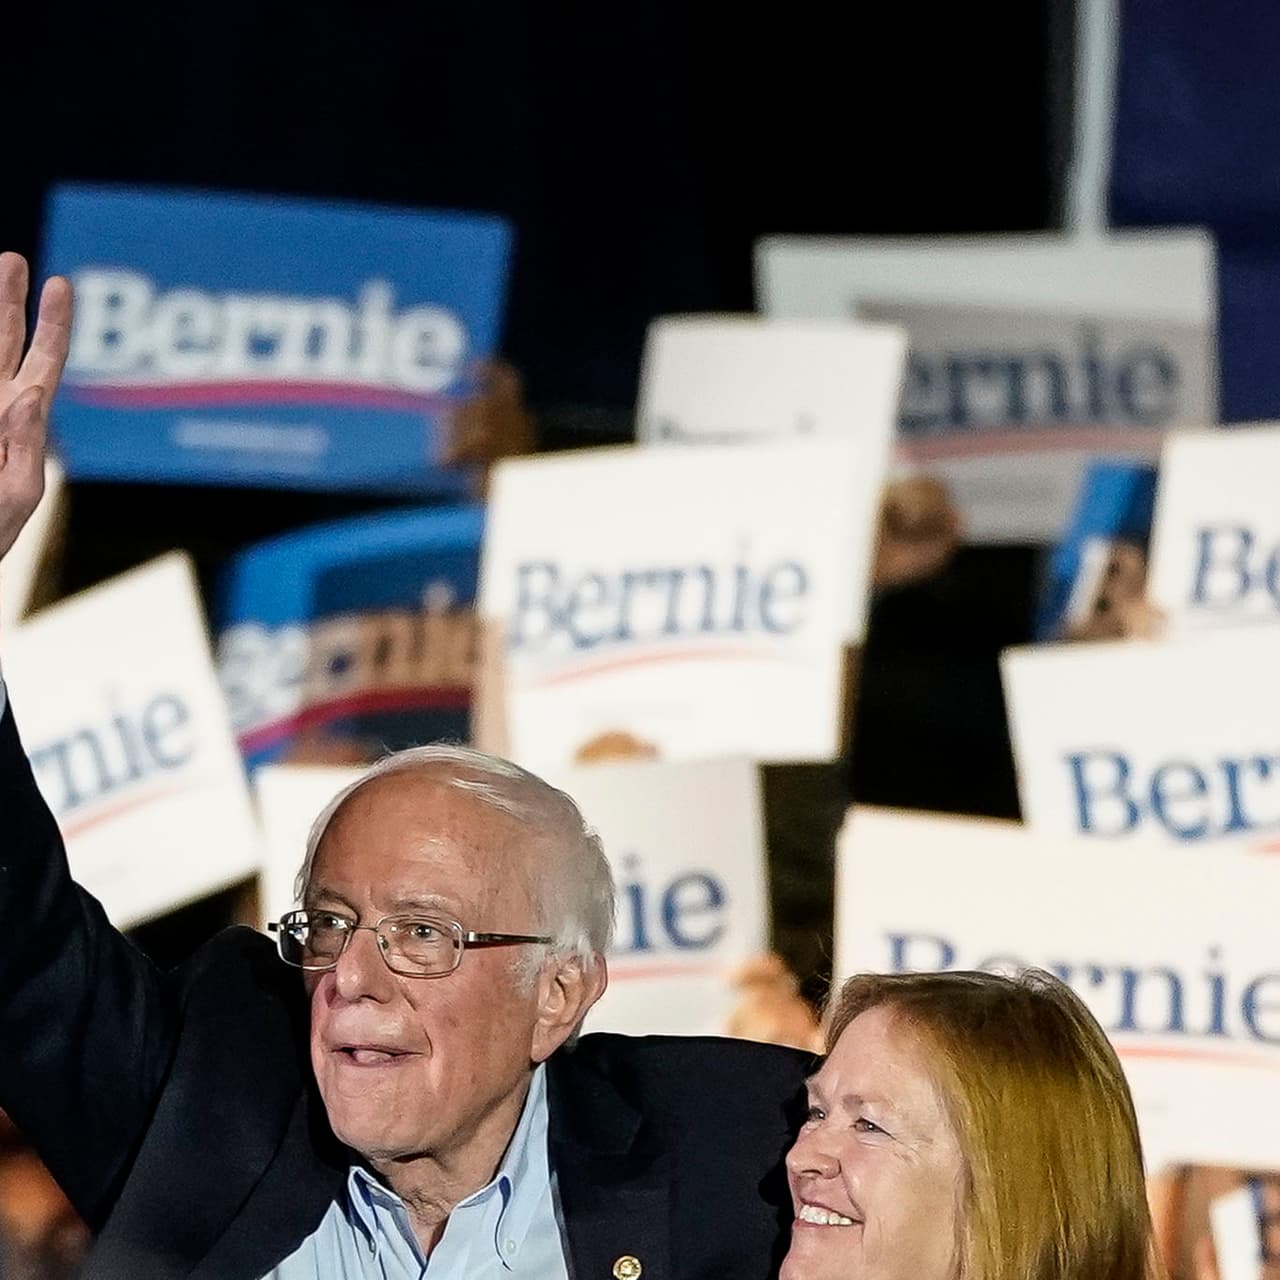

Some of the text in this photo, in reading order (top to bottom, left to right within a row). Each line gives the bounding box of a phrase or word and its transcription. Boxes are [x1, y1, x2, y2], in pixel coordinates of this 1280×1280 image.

[68, 264, 466, 394] Bernie
[894, 325, 1180, 434] ernie
[508, 532, 812, 652] Bernie
